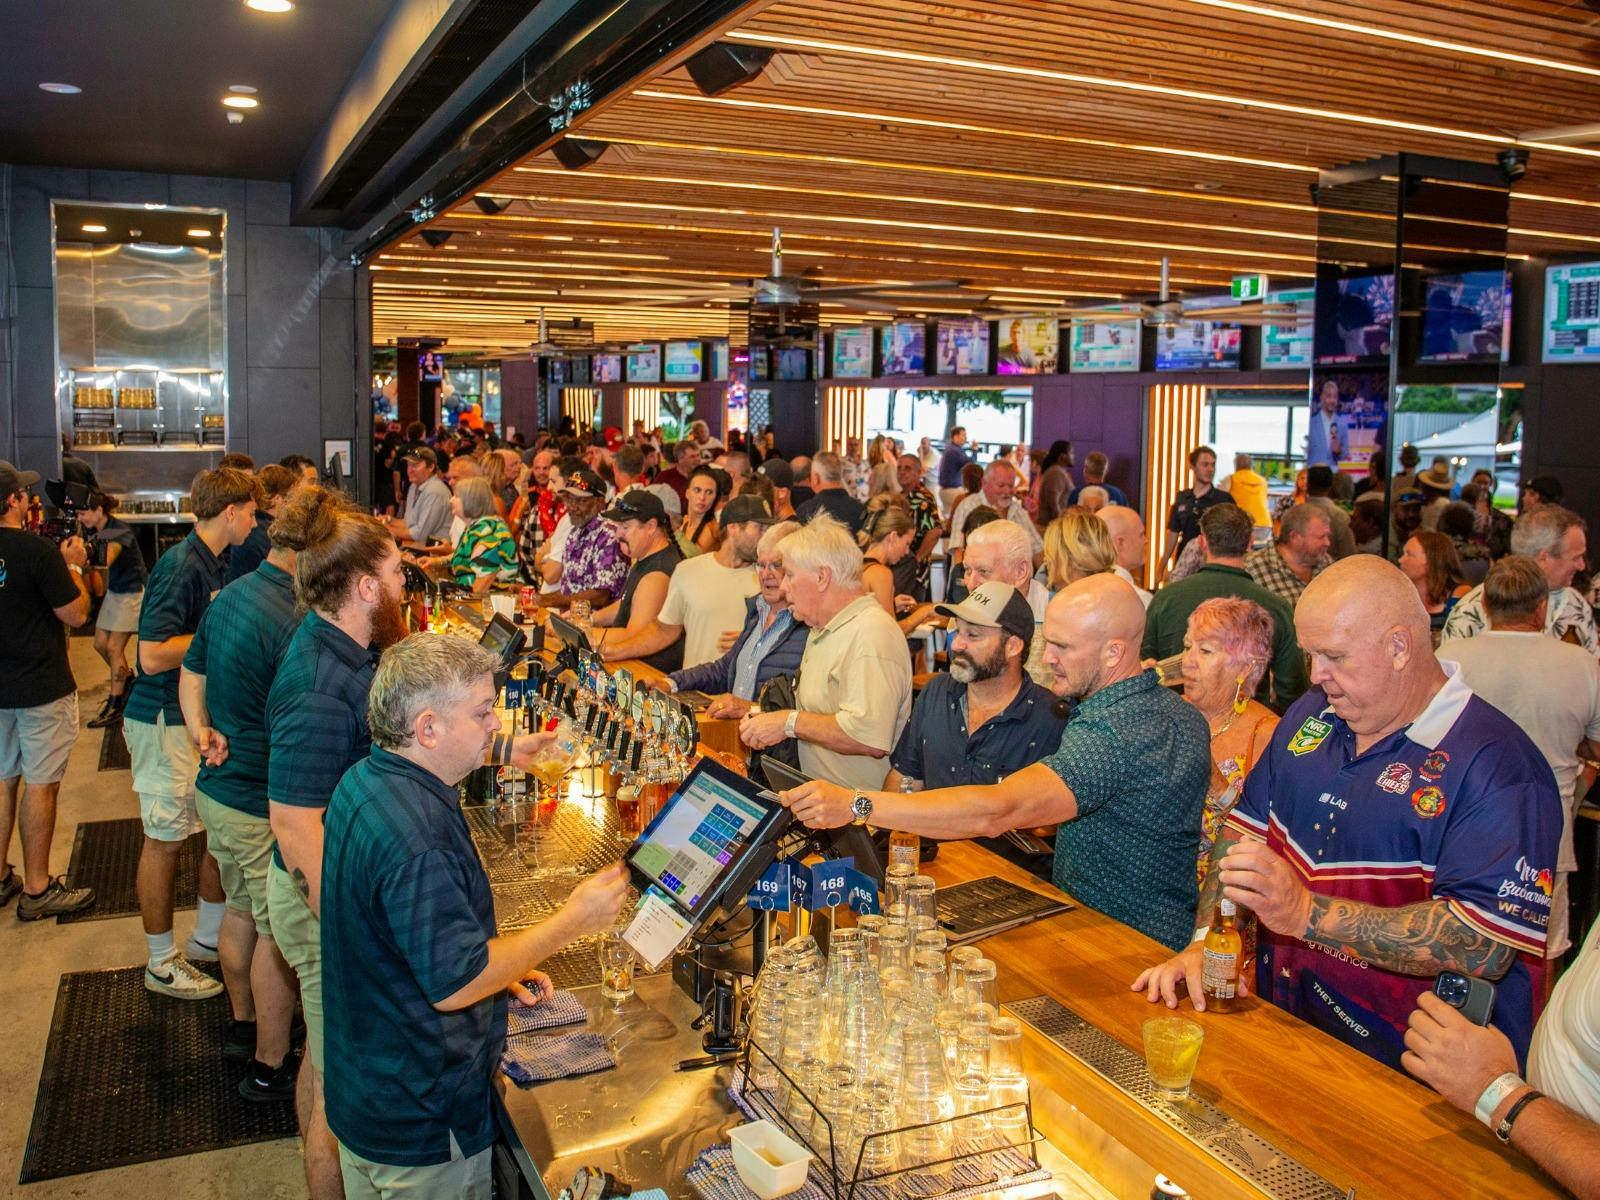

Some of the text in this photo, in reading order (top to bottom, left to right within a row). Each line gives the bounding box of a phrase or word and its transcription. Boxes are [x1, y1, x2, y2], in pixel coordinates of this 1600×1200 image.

[970, 591, 990, 606] FOX
[1306, 720, 1326, 734] NRL
[1378, 774, 1409, 794] CHIEFS
[1330, 796, 1347, 810] LAB
[756, 880, 779, 893] 169
[791, 875, 807, 891] 167
[820, 877, 845, 891] 168
[854, 886, 872, 903] 165
[1498, 900, 1521, 917] WE
[1317, 944, 1368, 969] insurance
[1313, 982, 1370, 1037] THEY SERVED
